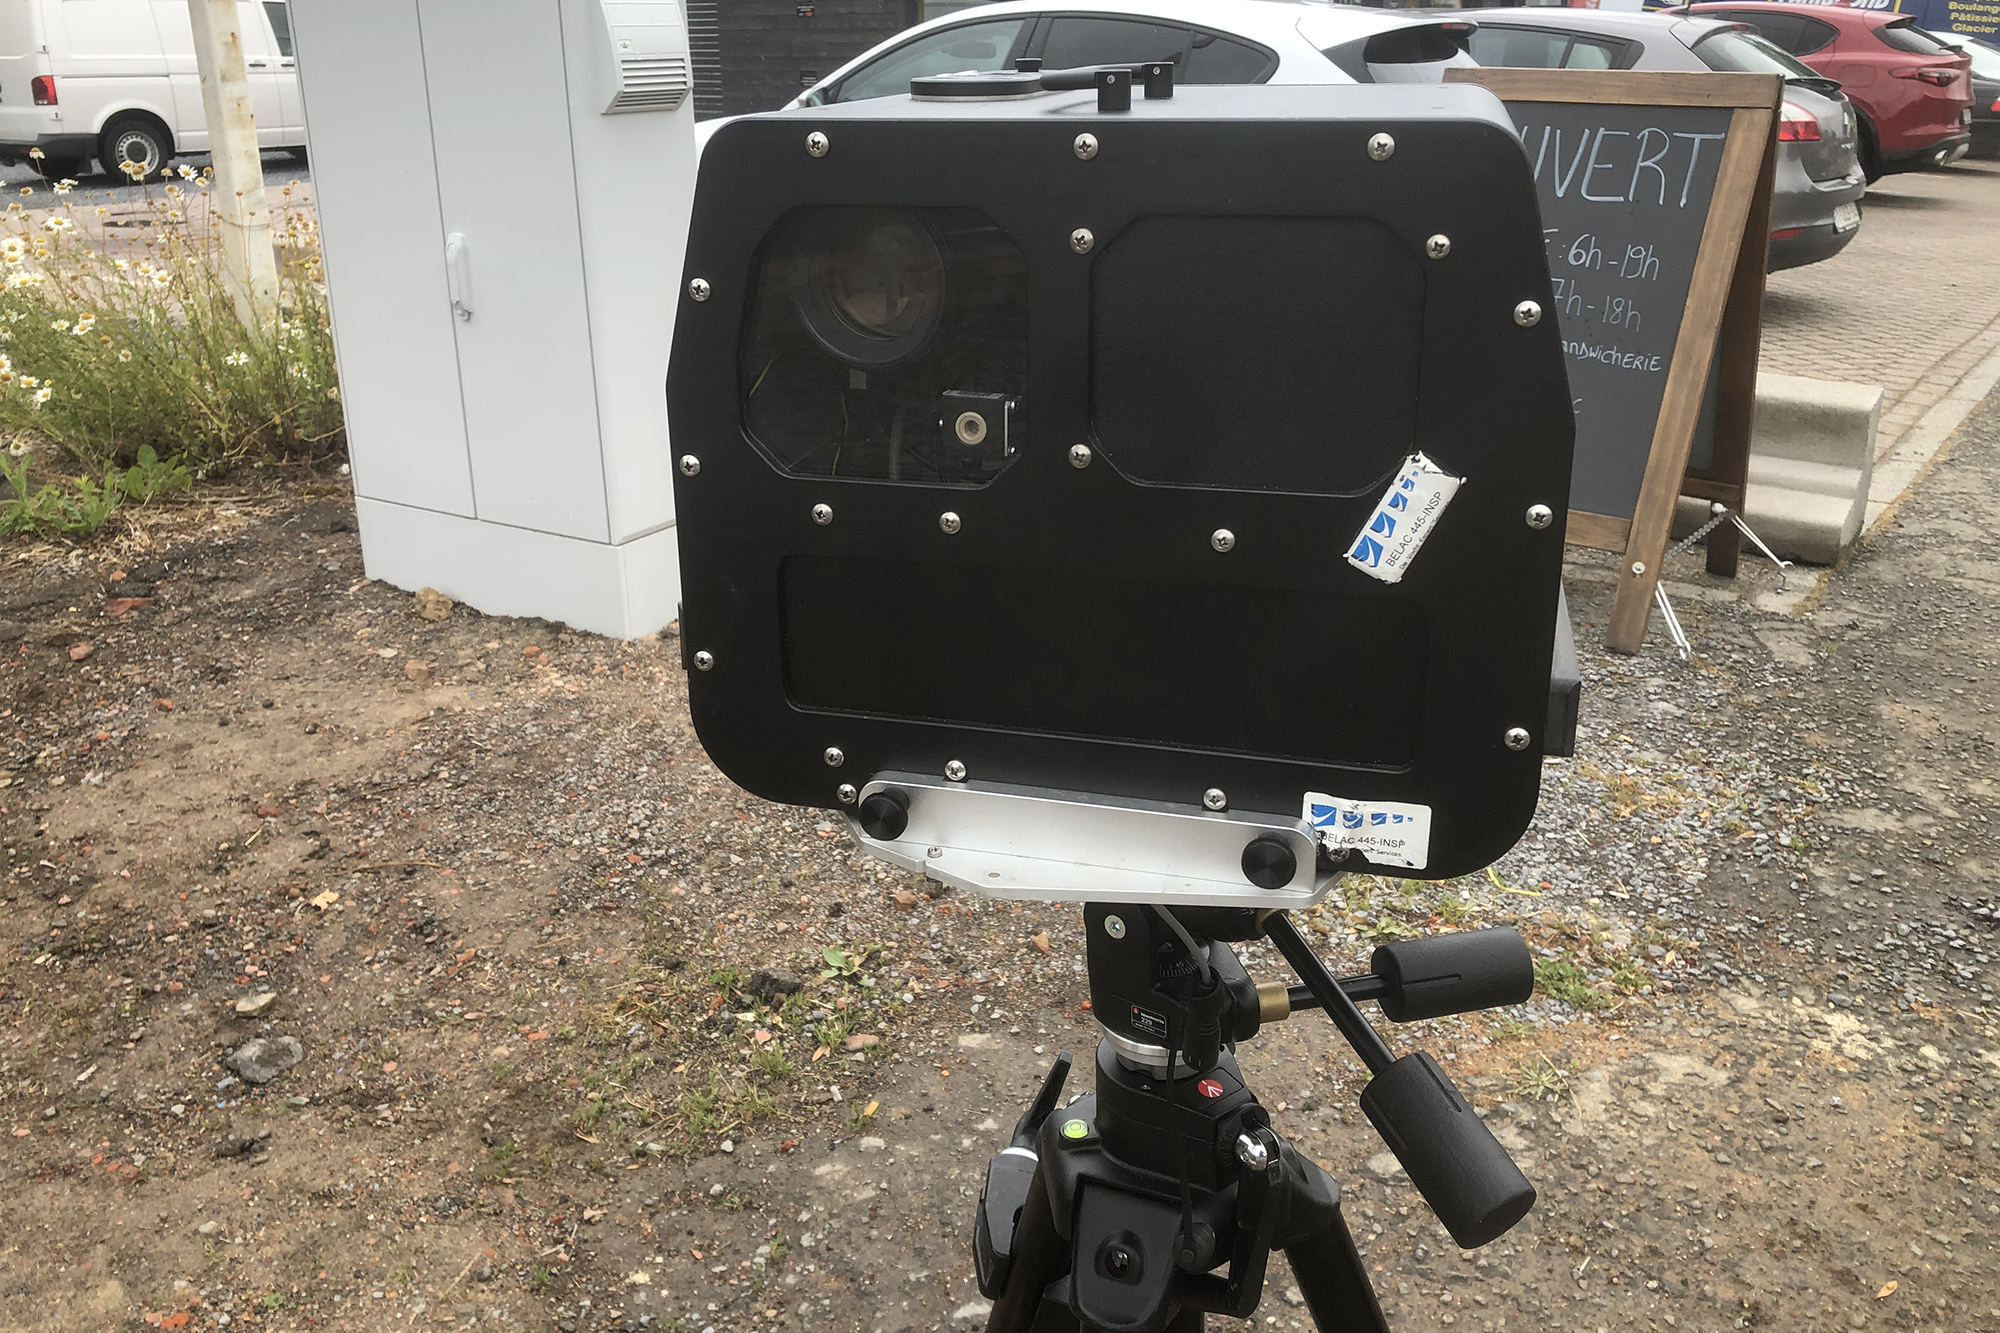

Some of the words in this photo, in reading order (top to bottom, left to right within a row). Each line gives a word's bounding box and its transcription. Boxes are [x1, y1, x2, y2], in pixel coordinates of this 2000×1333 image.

[1948, 1, 2000, 14] Boulang
[1950, 12, 2000, 24] Pâtissie
[1951, 22, 1998, 34] Glacier
[1385, 534, 1412, 567] BELAC
[1410, 491, 1441, 535] 445-INSP
[1357, 836, 1406, 849] 445-INSP
[1376, 849, 1402, 857] Services
